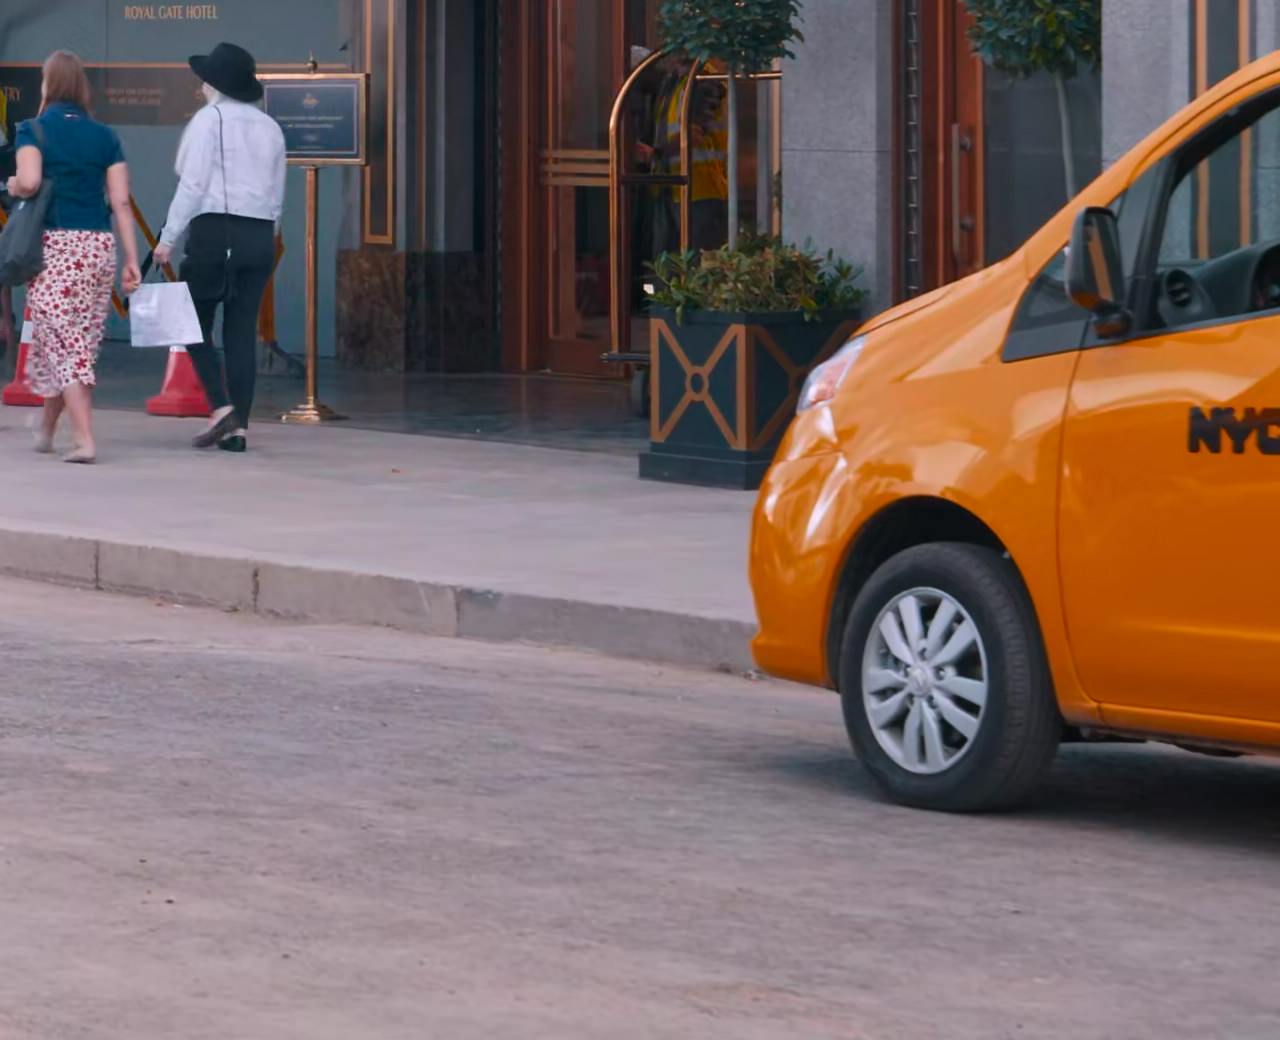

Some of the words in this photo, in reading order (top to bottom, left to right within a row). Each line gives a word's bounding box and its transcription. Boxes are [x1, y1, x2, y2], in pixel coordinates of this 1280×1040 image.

[124, 5, 155, 20] ROYAL
[159, 5, 184, 20] GATE
[186, 4, 219, 20] HOTEL
